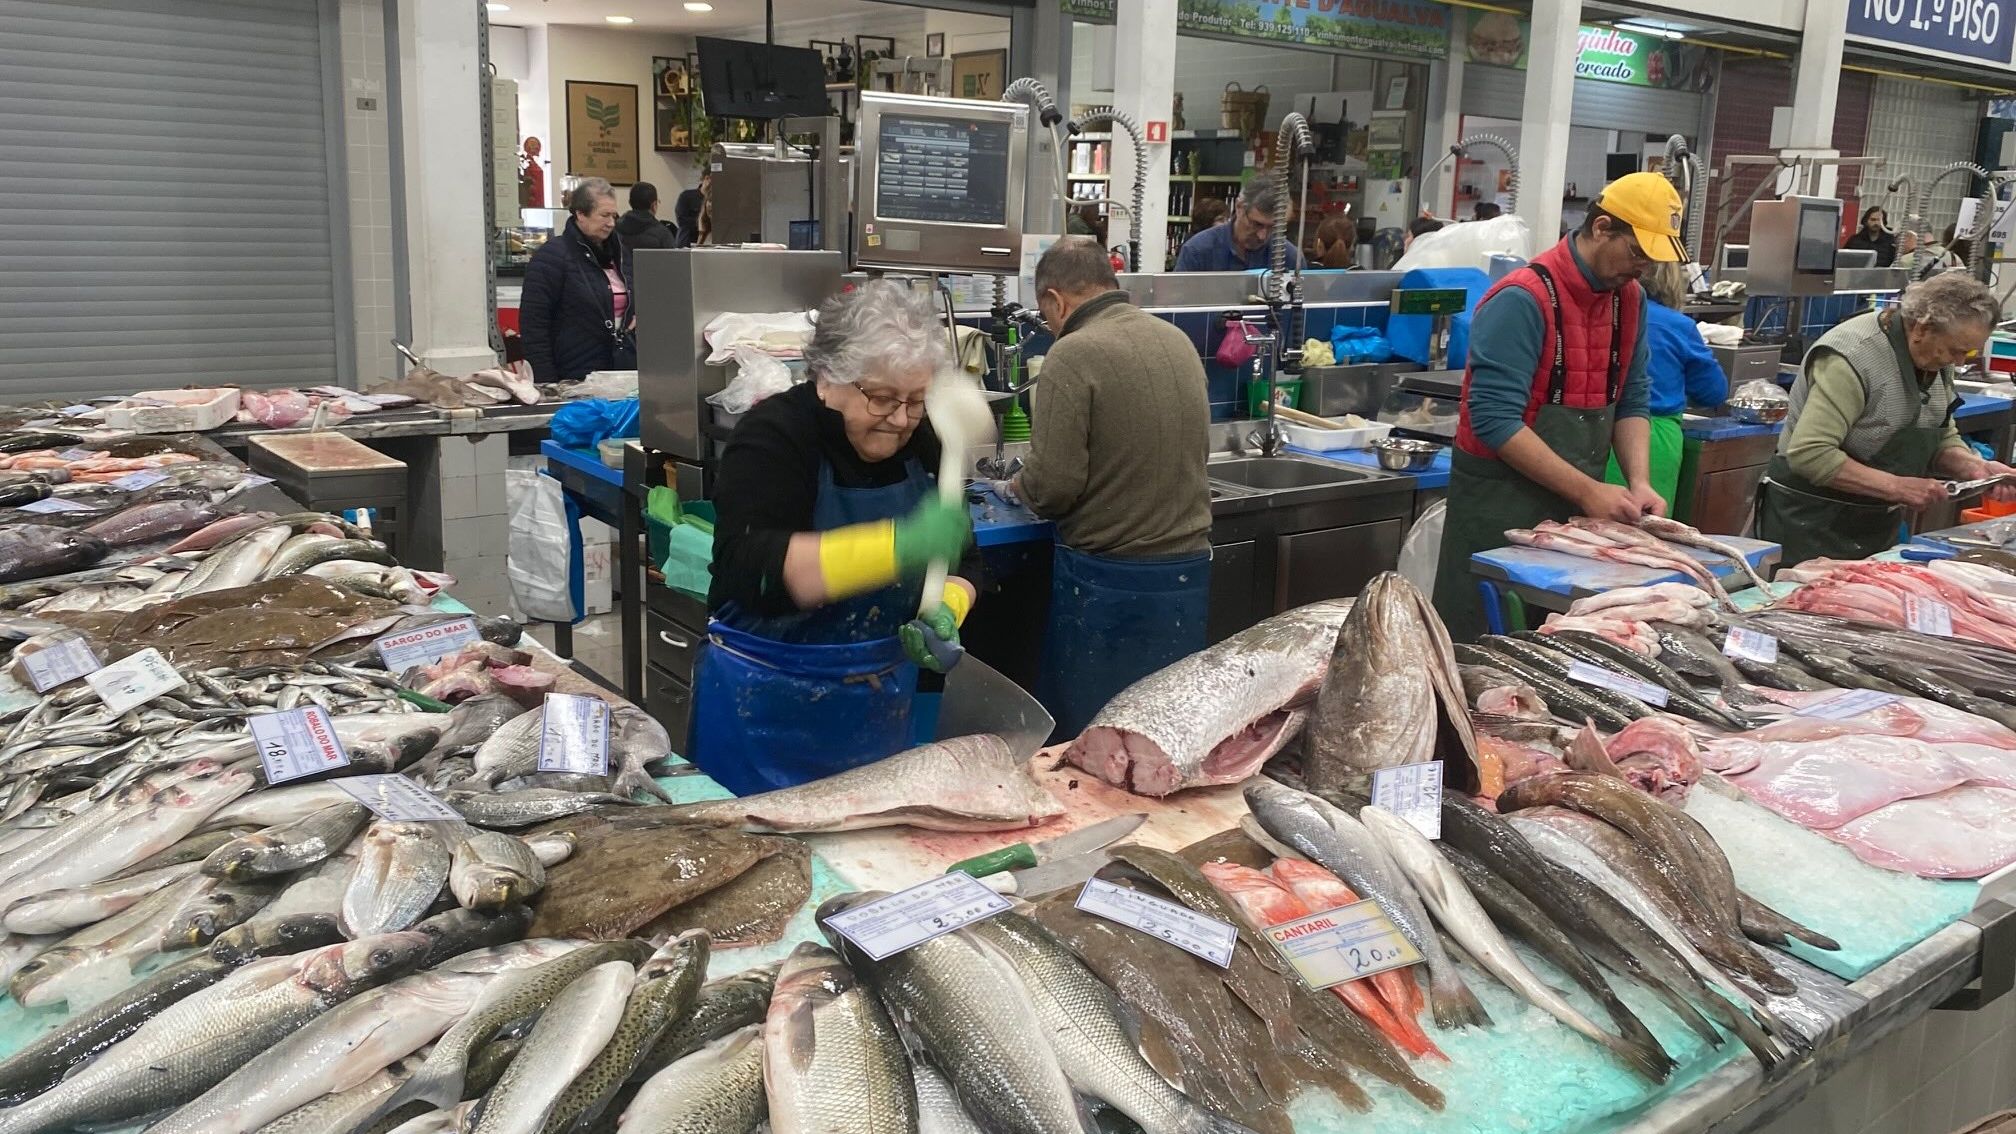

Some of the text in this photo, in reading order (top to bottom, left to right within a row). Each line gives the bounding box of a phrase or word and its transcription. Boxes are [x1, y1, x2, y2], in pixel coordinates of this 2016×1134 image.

[1192, 11, 1232, 26] Produtor
[1240, 18, 1256, 29] Tel:
[1258, 21, 1275, 32] 939
[1277, 24, 1292, 35] 125
[1948, 0, 2000, 45] PISO
[383, 622, 469, 649] SARGO DO MAR
[305, 710, 338, 761] ROBALO DO MAR
[1273, 918, 1338, 942] CANTARIL
